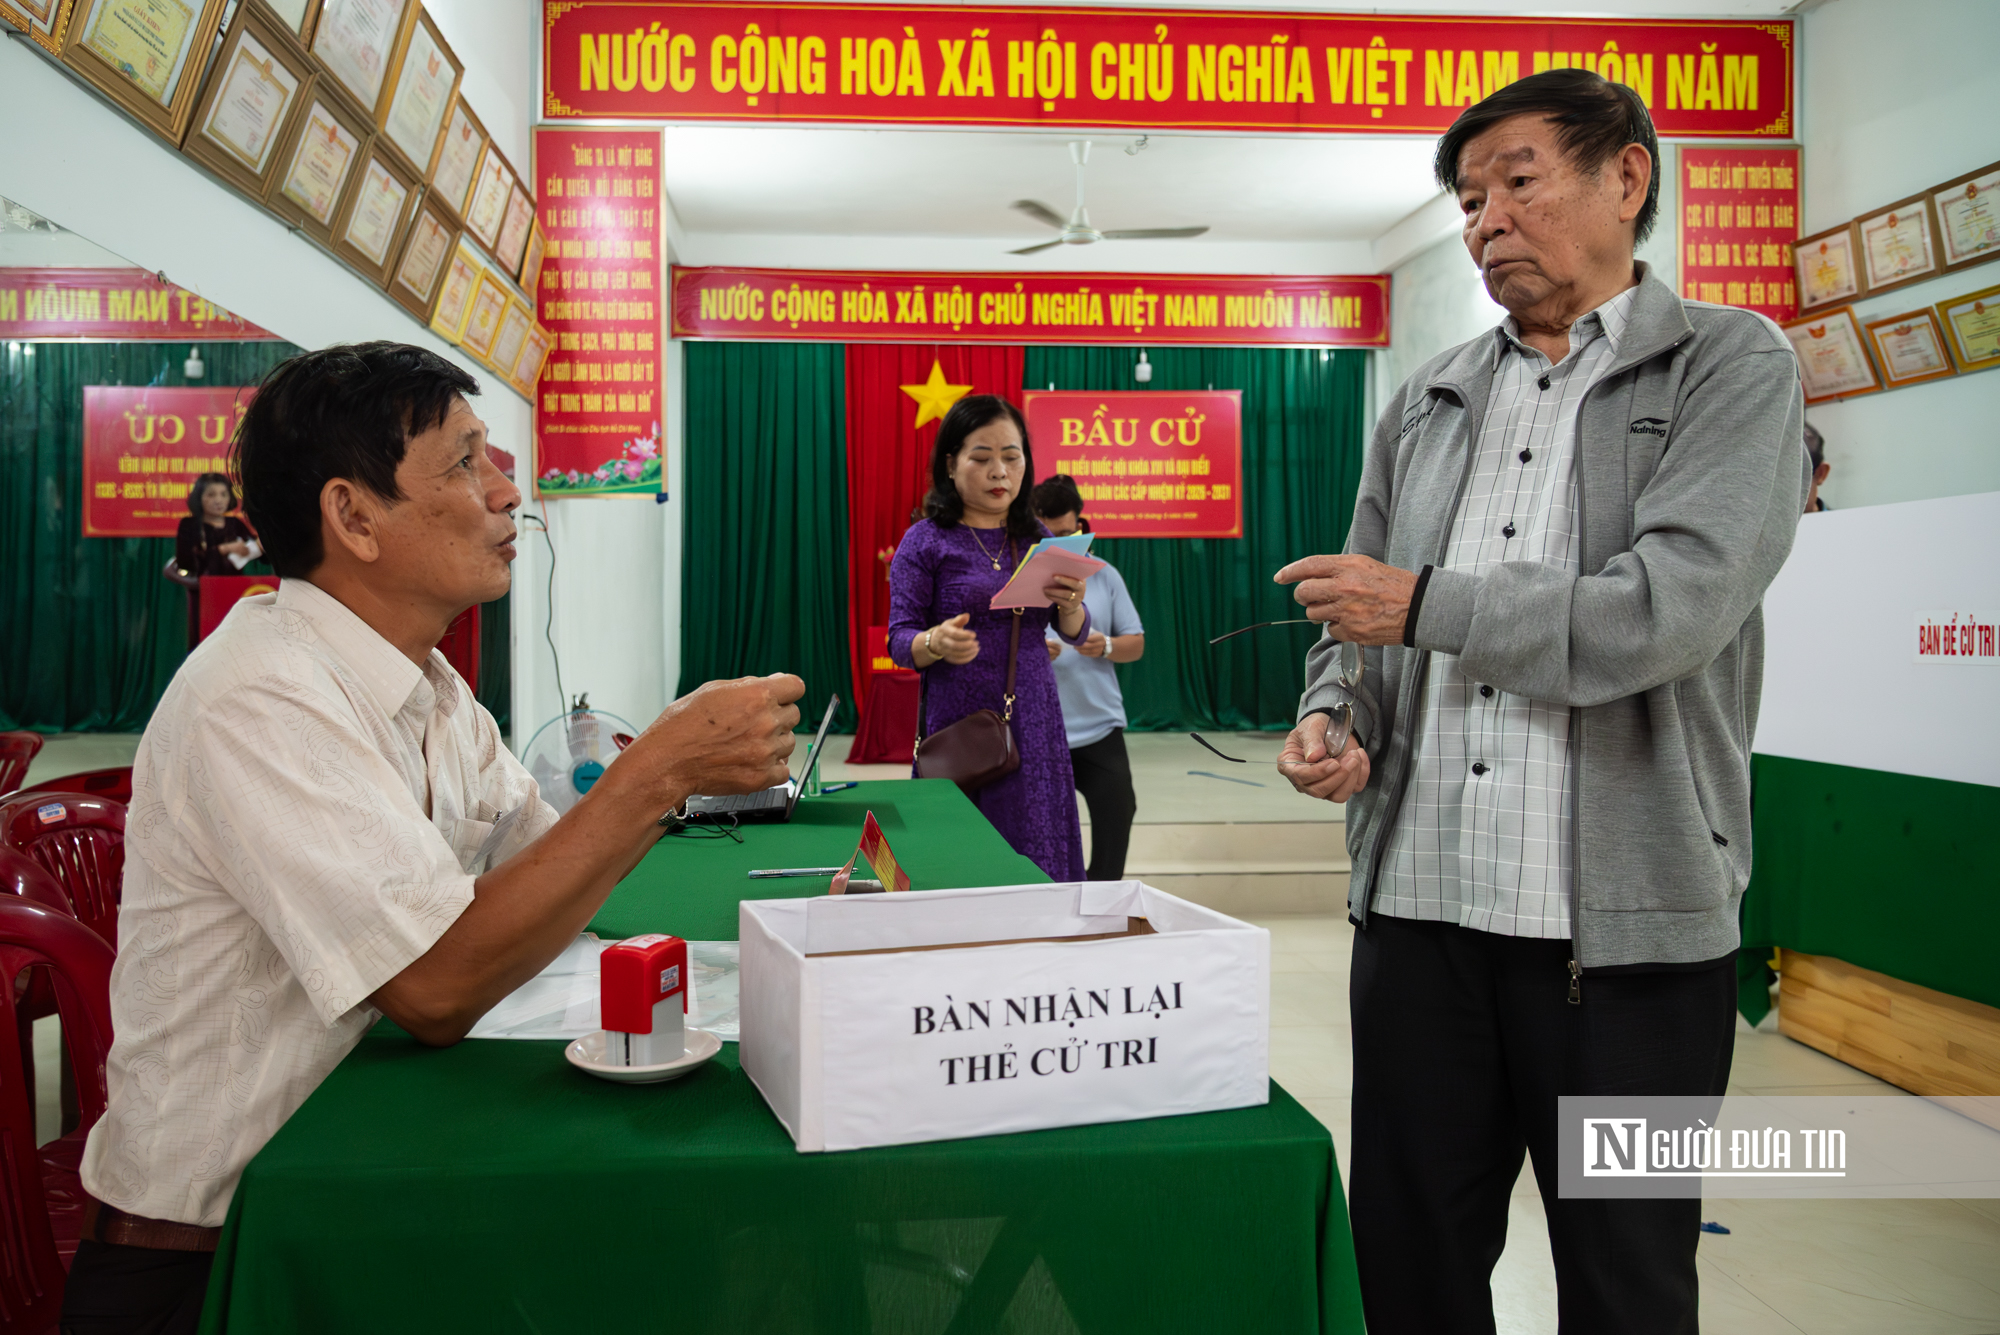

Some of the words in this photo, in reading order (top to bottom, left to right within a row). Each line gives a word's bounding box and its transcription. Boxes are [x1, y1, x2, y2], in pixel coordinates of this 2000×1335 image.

[579, 22, 696, 93] NƯỚC
[711, 23, 827, 107] CỘNG
[841, 27, 925, 97] HOÀ
[938, 29, 995, 98] XÃ
[1008, 30, 1076, 112] HỘI
[1091, 24, 1174, 103] CHỦ
[1187, 35, 1314, 103] NGHĨA
[1326, 36, 1413, 118] VIỆT
[1425, 50, 1519, 106] NAM
[1666, 42, 1759, 111] NĂM
[701, 282, 764, 321] NƯỚC
[771, 283, 835, 329] CỘNG
[842, 282, 889, 323] HÒA
[895, 285, 928, 323] XÃ
[934, 285, 973, 331] HỘI
[979, 281, 1026, 325] CHỦ
[1032, 287, 1104, 326] NGHĨA
[1109, 287, 1158, 333] VIỆT
[1165, 295, 1218, 327] NAM
[1224, 289, 1294, 328] MUÔN
[1299, 290, 1362, 329] NĂM!
[1059, 403, 1140, 447] BẦU
[1150, 406, 1206, 447] CỬ
[1919, 618, 1940, 655] BÀN
[1943, 612, 1958, 656] ĐỂ
[1960, 614, 1976, 656] CỬ
[1978, 624, 1995, 657] TRI
[912, 994, 992, 1036] BÀN
[1003, 987, 1111, 1028] NHẬN
[1121, 981, 1184, 1019] LẠI
[939, 1043, 1018, 1086] THẺ
[1031, 1037, 1089, 1076] CỬ
[1097, 1036, 1159, 1070] TRI
